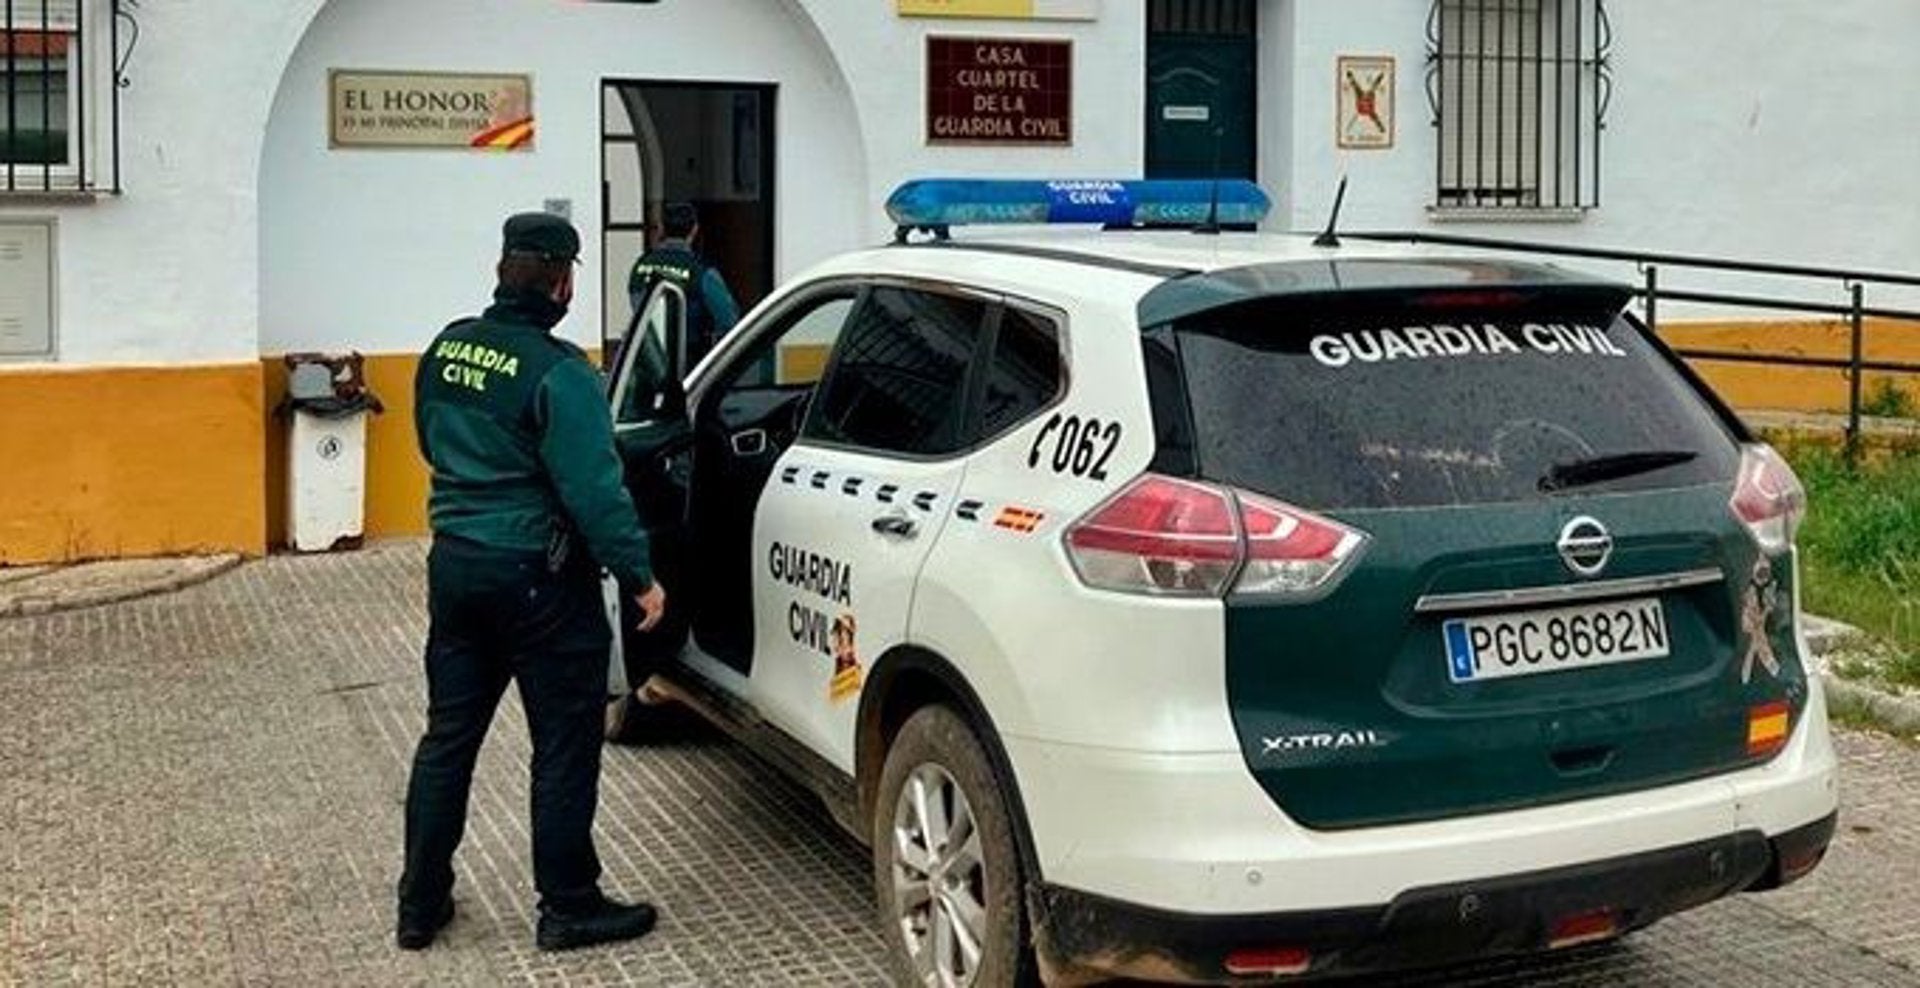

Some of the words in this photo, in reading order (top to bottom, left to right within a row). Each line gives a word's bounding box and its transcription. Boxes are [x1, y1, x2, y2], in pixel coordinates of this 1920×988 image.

[976, 46, 1026, 65] CASA
[957, 70, 1040, 88] CUARTEL
[345, 90, 373, 111] EL
[384, 90, 489, 111] HONOR
[974, 95, 998, 112] DE
[1003, 95, 1026, 112] LA
[934, 116, 1015, 136] GUARDIA
[1021, 118, 1065, 136] CIVIL
[1068, 191, 1116, 204] CIVIL
[1309, 323, 1522, 367] GUARDIA
[1521, 323, 1628, 357] CIVIL
[436, 341, 519, 377] GUARDIA
[442, 363, 487, 391] CIVIL
[1052, 414, 1122, 482] 062
[768, 541, 851, 607] GUARDIA
[789, 600, 832, 656] CIVIL
[1262, 730, 1387, 755] X-TRAIL
